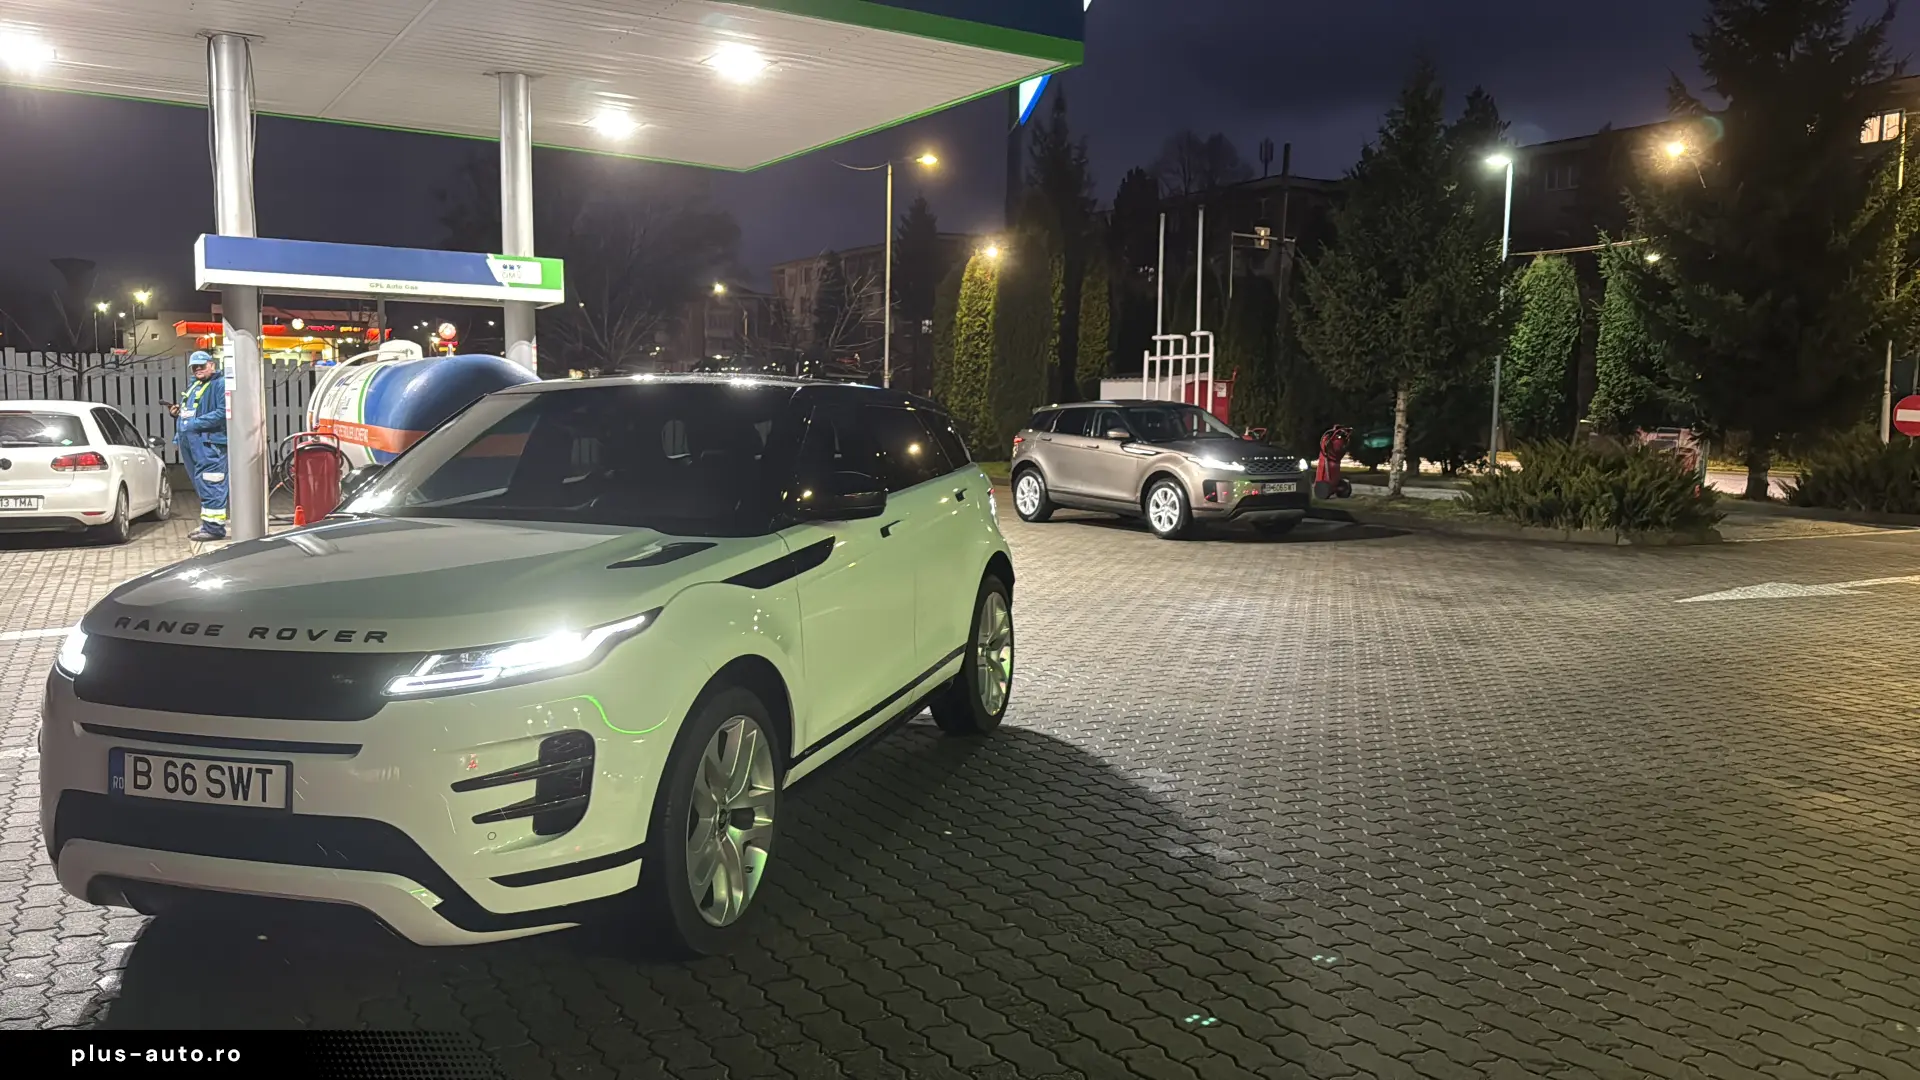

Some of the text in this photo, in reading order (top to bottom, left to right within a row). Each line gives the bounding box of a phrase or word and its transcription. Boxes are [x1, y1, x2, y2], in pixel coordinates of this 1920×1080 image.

[13, 497, 33, 507] TMA
[114, 616, 388, 643] RANGE ROVER
[112, 775, 125, 790] RO
[133, 756, 273, 803] B 66 SWT
